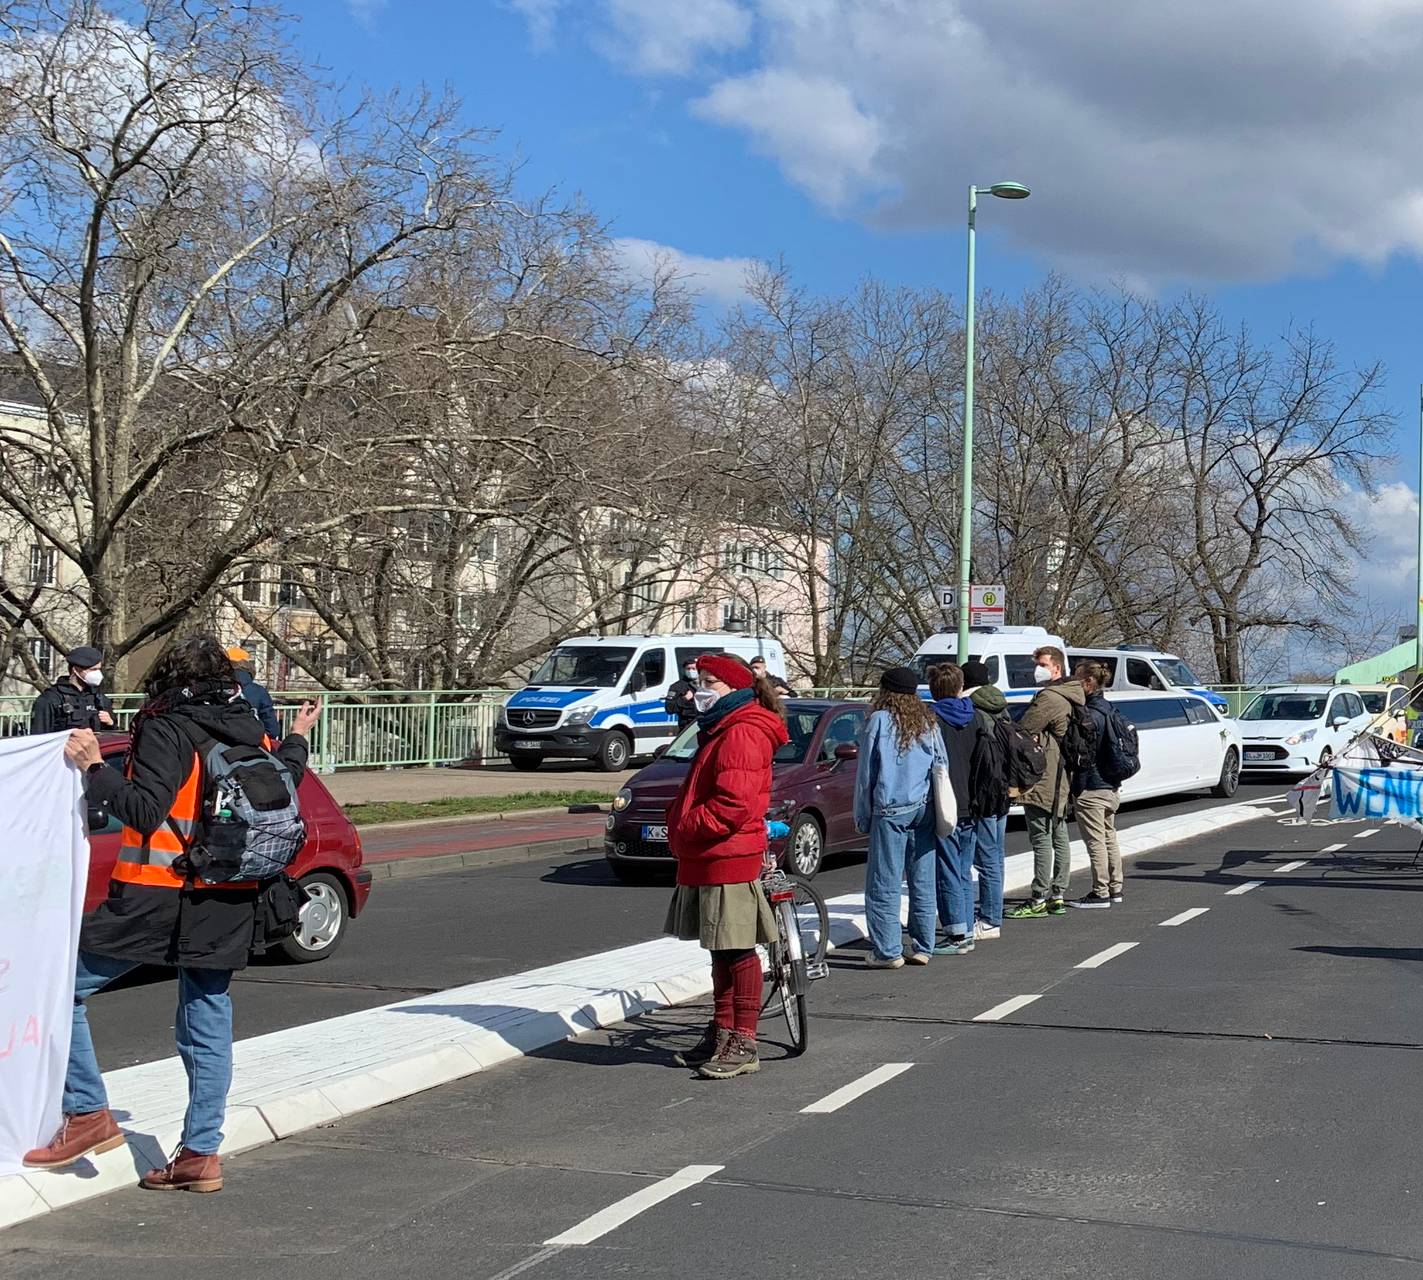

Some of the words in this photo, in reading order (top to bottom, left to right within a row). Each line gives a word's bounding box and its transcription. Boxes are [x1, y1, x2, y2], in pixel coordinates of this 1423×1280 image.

[943, 592, 953, 605] D
[519, 696, 562, 704] POLIZEI
[648, 827, 654, 838] K
